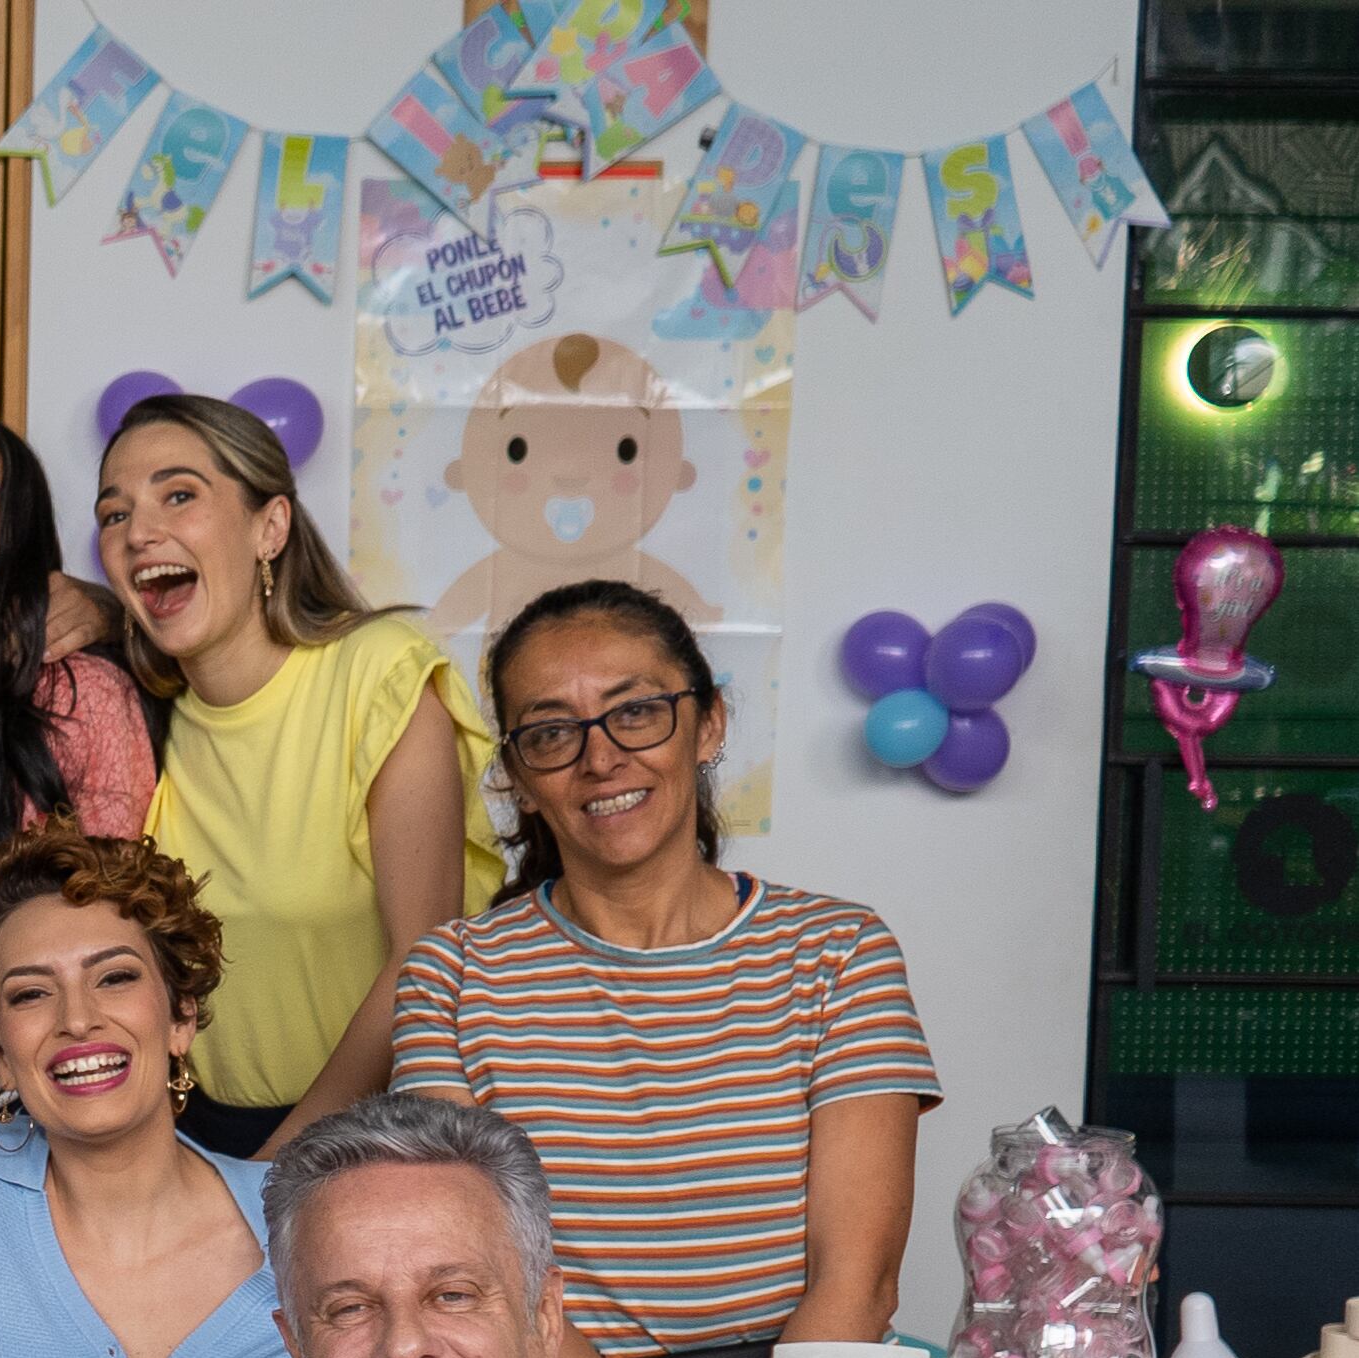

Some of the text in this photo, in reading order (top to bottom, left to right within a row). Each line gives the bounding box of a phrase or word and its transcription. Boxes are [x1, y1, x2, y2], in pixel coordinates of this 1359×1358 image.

[416, 253, 527, 307] EL CHUPÓN
[426, 233, 502, 273] PONLE
[434, 281, 528, 336] AL BEBÉ
